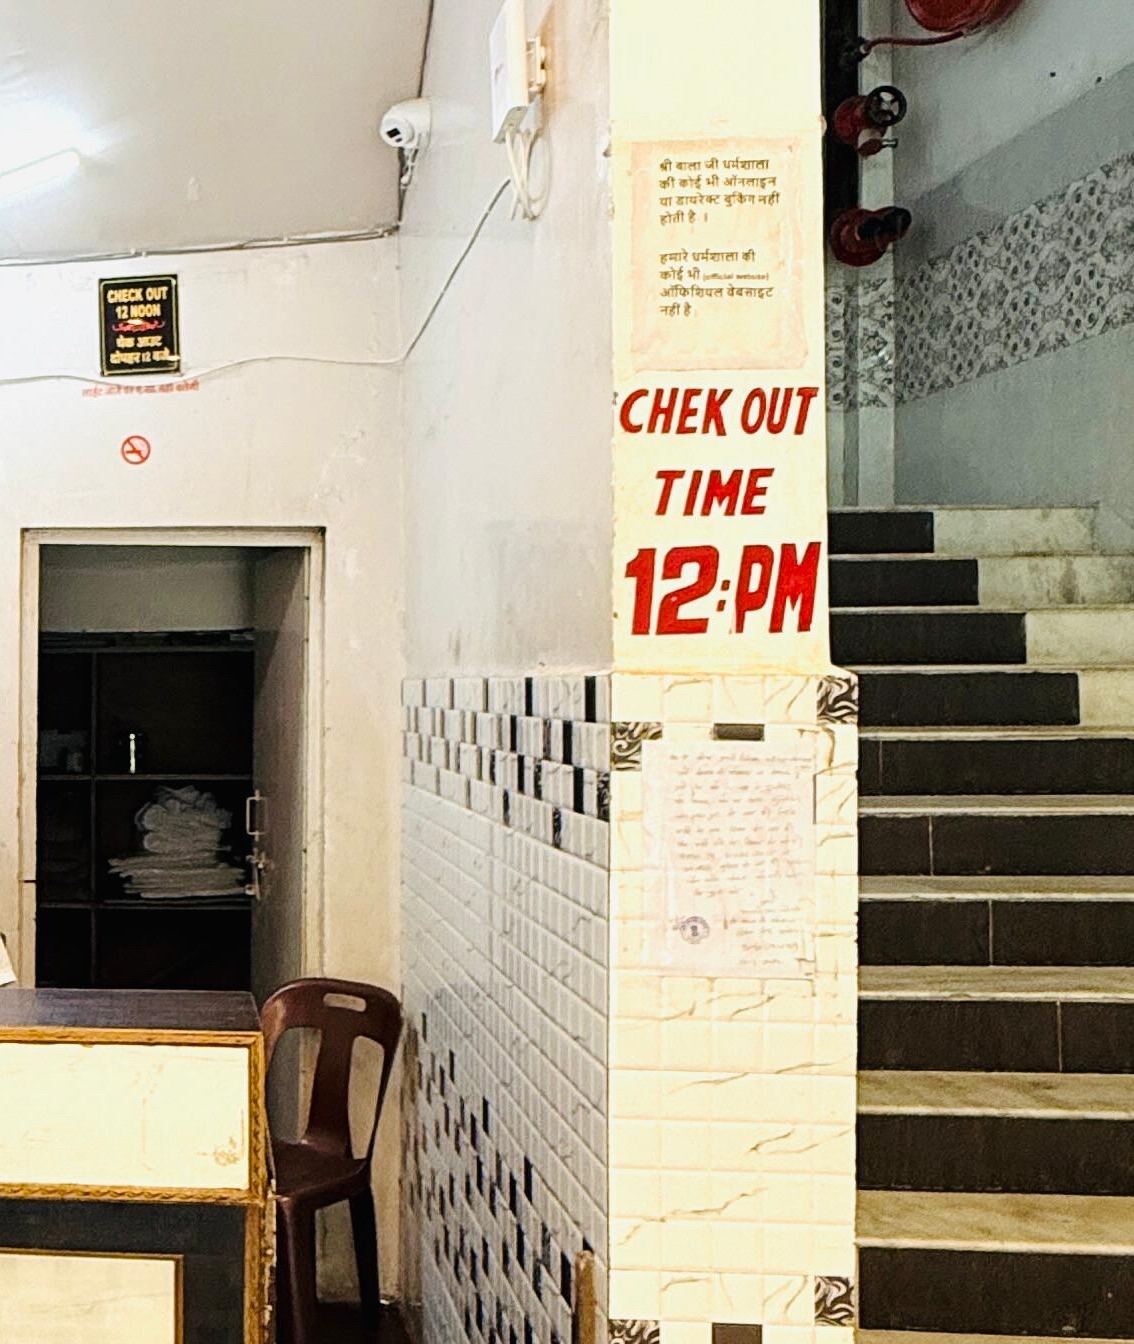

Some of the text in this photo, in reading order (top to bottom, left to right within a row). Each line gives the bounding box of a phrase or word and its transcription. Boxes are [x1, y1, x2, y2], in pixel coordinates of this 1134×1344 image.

[705, 157, 719, 170] जी
[722, 157, 770, 170] धर्मशाला
[659, 176, 675, 189] की
[679, 175, 702, 189] कोई
[706, 174, 719, 187] भी
[659, 196, 673, 206] या
[659, 210, 684, 226] होती
[688, 209, 696, 224] है
[659, 248, 756, 264] हमारे धर्मशाला की
[659, 266, 684, 281] कोई
[687, 266, 700, 280] भी
[107, 286, 169, 303] CHECK OUT
[115, 303, 161, 319] 12 NOON
[684, 301, 692, 317] है
[619, 386, 819, 436] CHEK OUT
[655, 468, 775, 516] TIME
[625, 541, 821, 635] 12:PM
